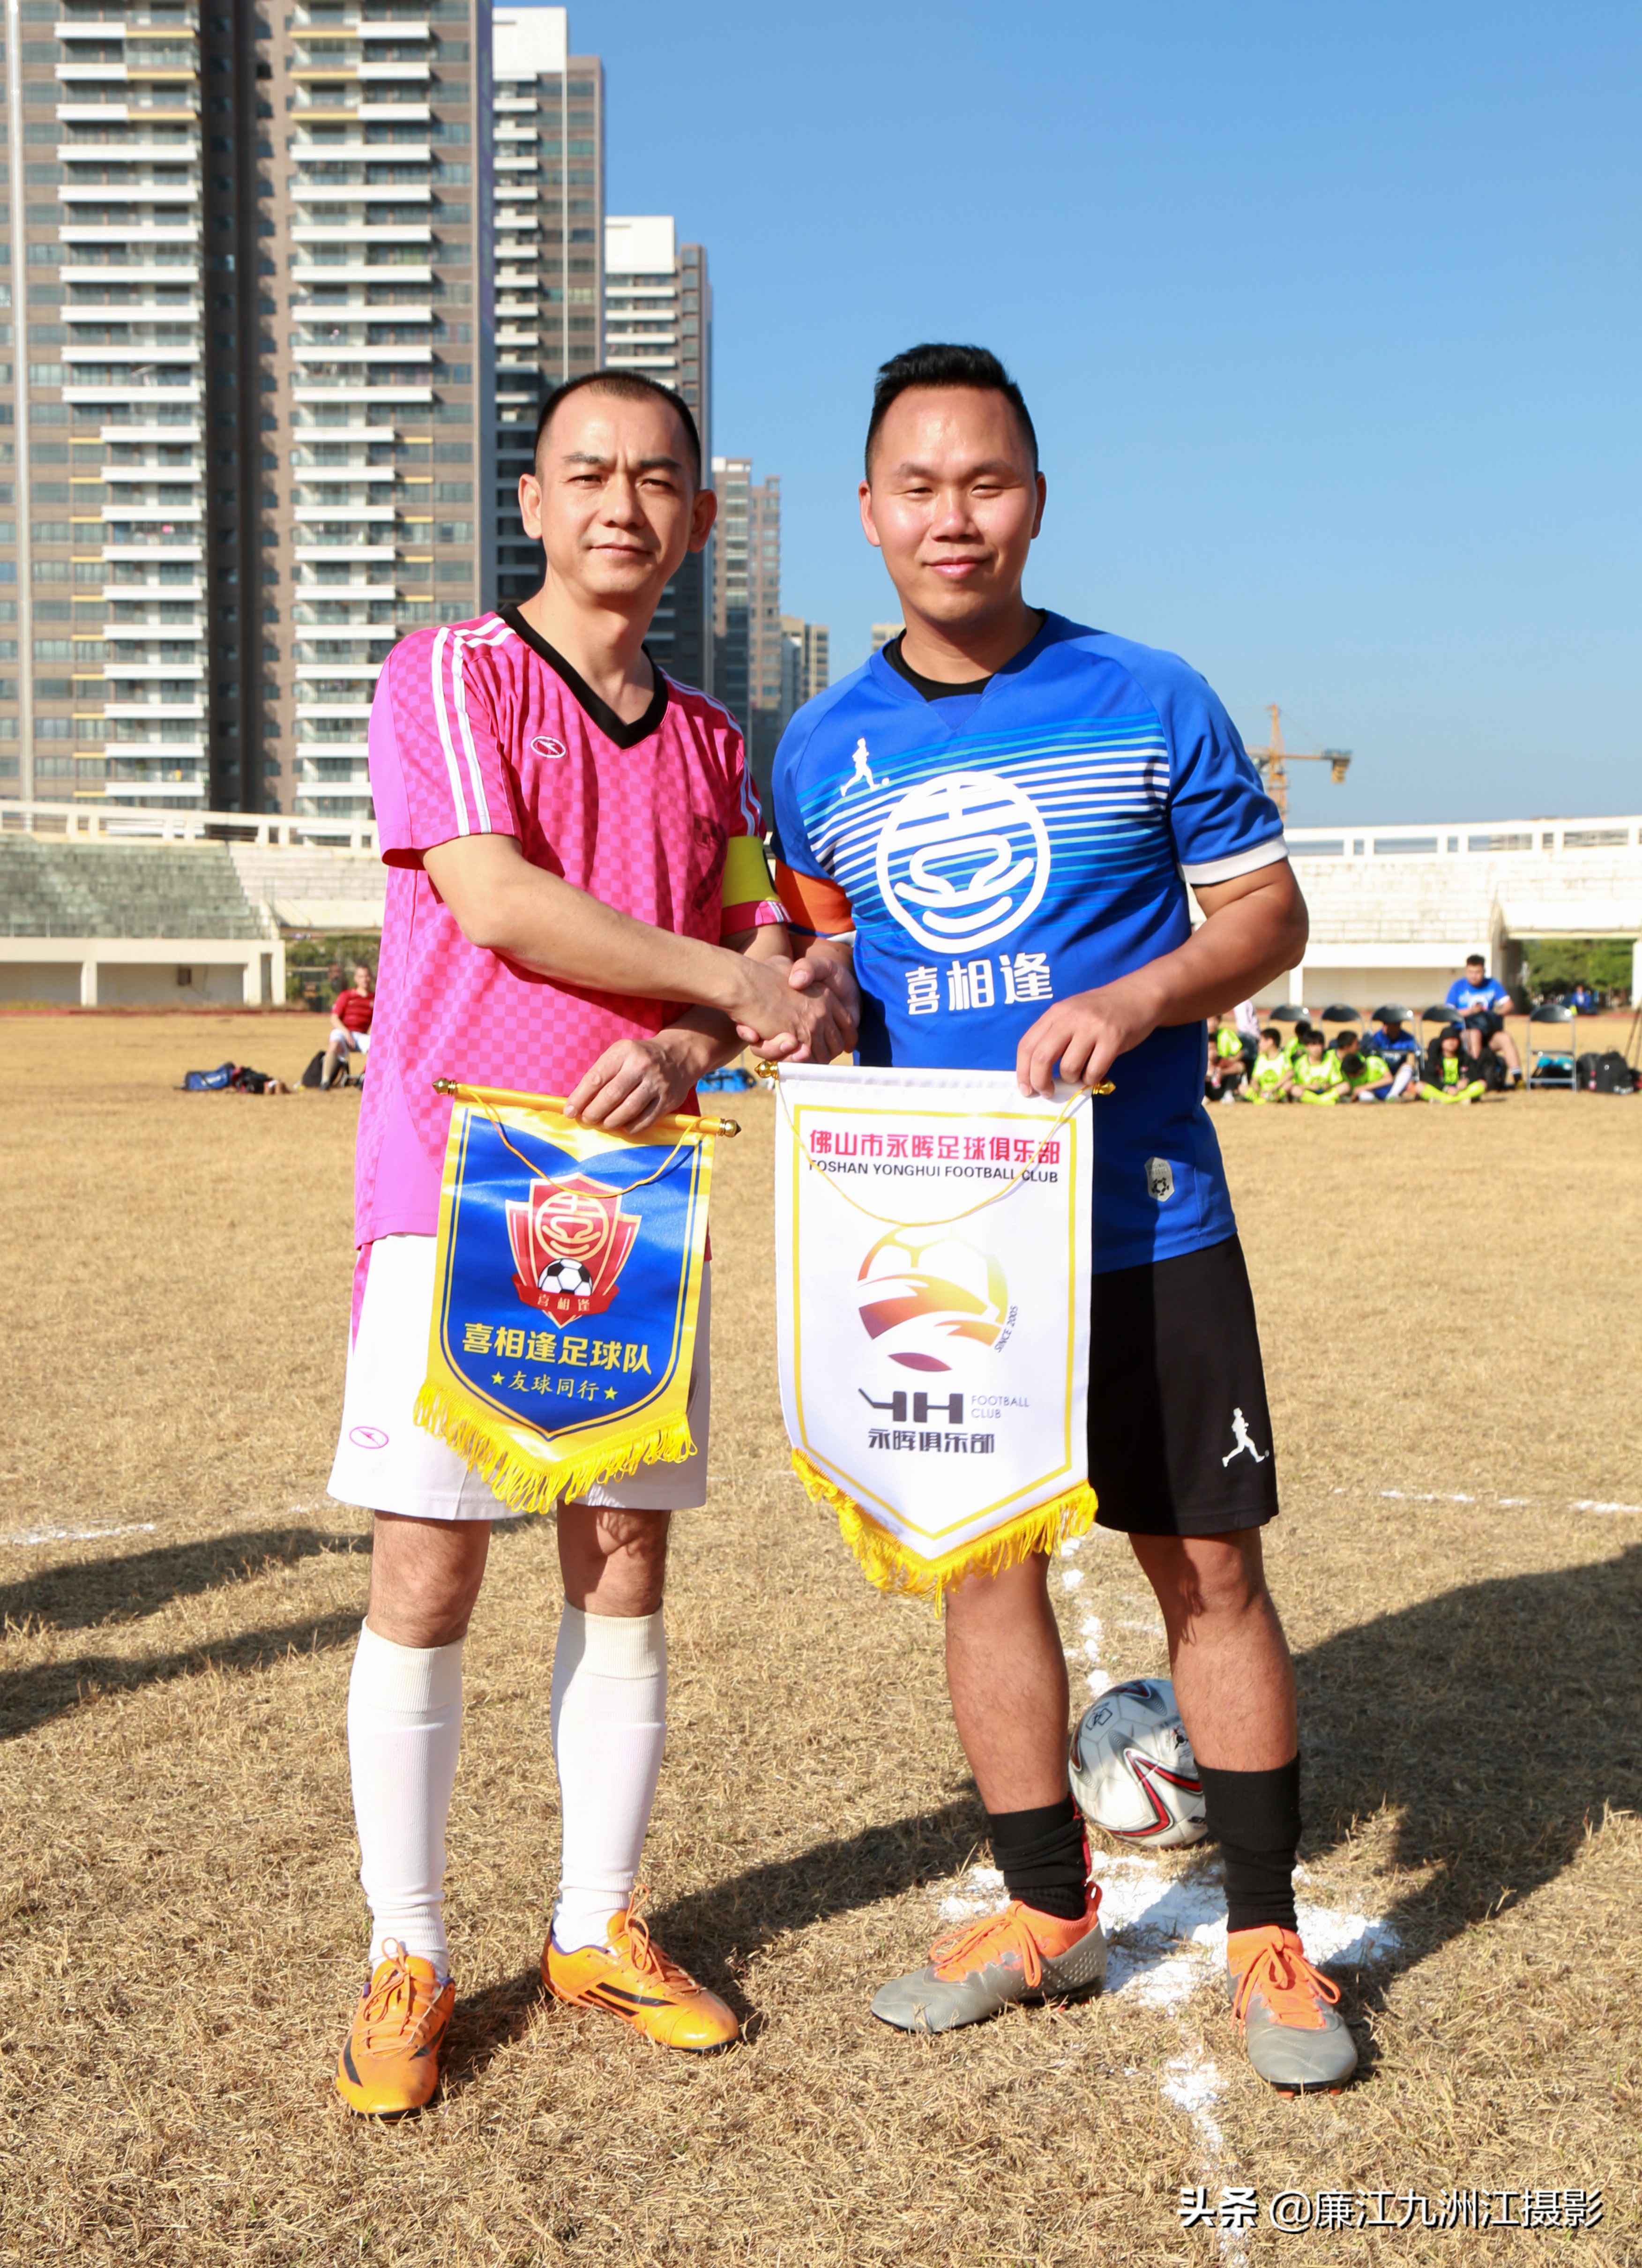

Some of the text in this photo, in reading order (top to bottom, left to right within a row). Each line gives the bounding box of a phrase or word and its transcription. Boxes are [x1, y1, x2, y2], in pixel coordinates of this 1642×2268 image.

[905, 952, 1053, 1015] 喜相逢
[810, 1130, 1060, 1165] 佛山市永晖足球俱乐部
[873, 1164, 940, 1177] YONGHUI
[945, 1166, 1016, 1180] FOOTBALL
[1022, 1170, 1058, 1183] CLUB
[537, 1294, 590, 1312] 喜相逢
[462, 1323, 652, 1375] 喜相逢足球队
[508, 1370, 599, 1402] 友球同行
[970, 1395, 1030, 1407] FOOTBALL
[970, 1408, 1001, 1419] CLUB
[868, 1428, 995, 1454] 永晖俱乐部
